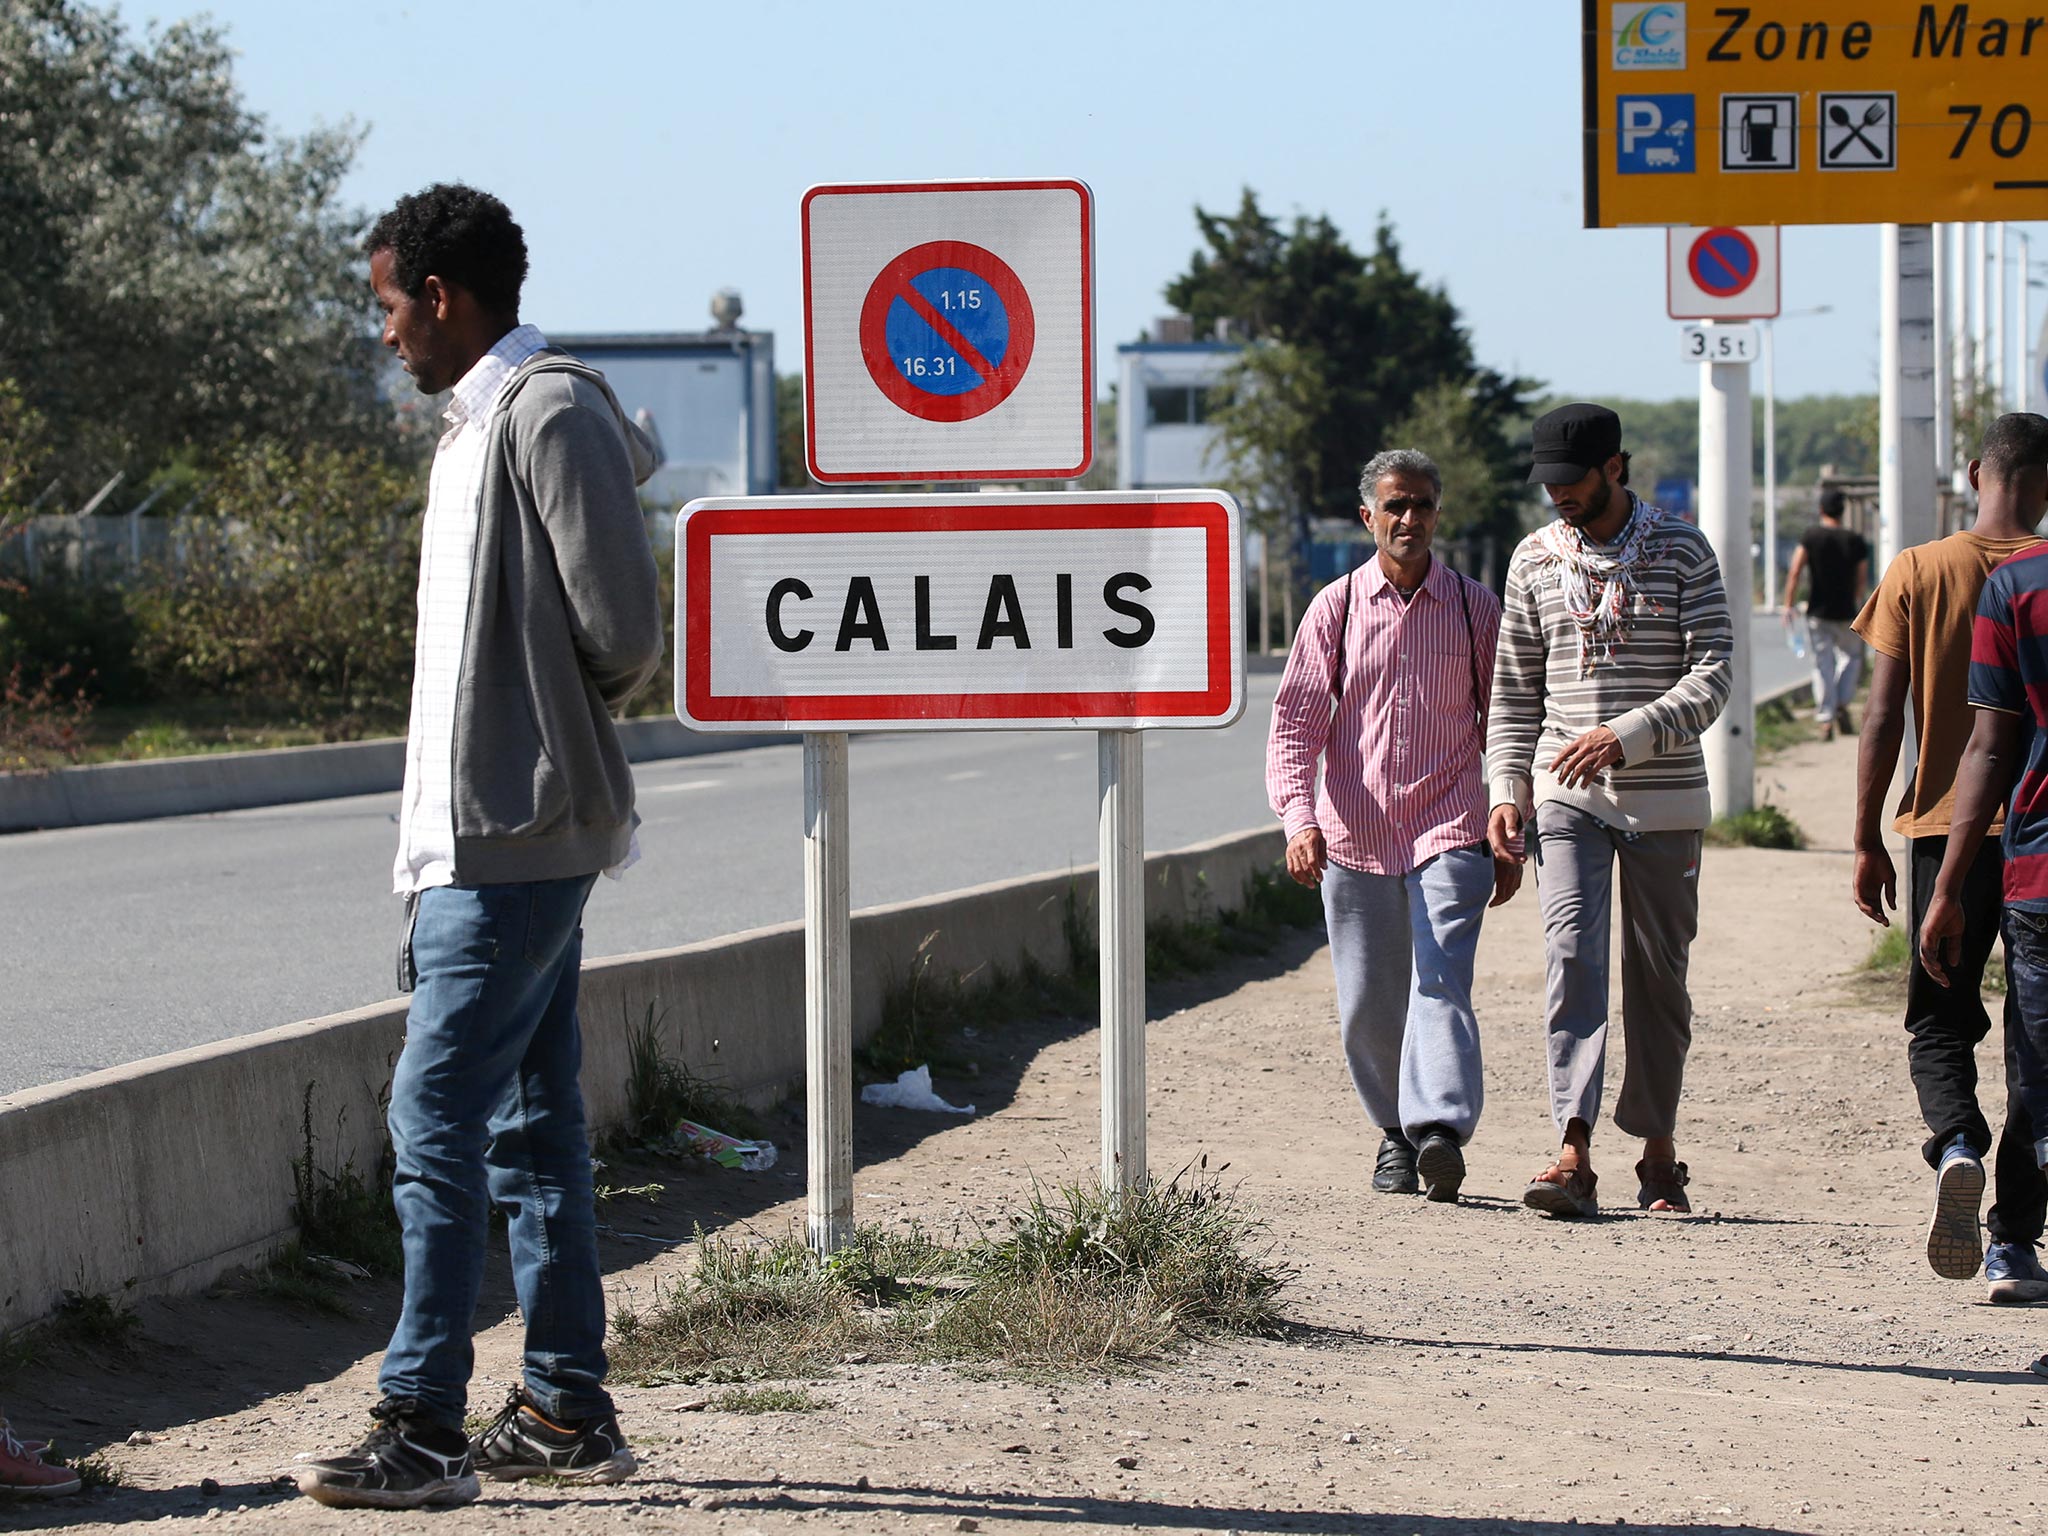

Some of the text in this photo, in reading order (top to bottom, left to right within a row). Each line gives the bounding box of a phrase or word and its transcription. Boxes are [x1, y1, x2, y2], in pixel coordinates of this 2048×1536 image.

[1707, 4, 2045, 61] Zone Mar
[1622, 102, 1662, 154] P
[1948, 103, 2031, 159] 70
[941, 289, 981, 310] 1.15
[903, 356, 955, 376] 16.31
[766, 572, 1155, 652] CALAIS
